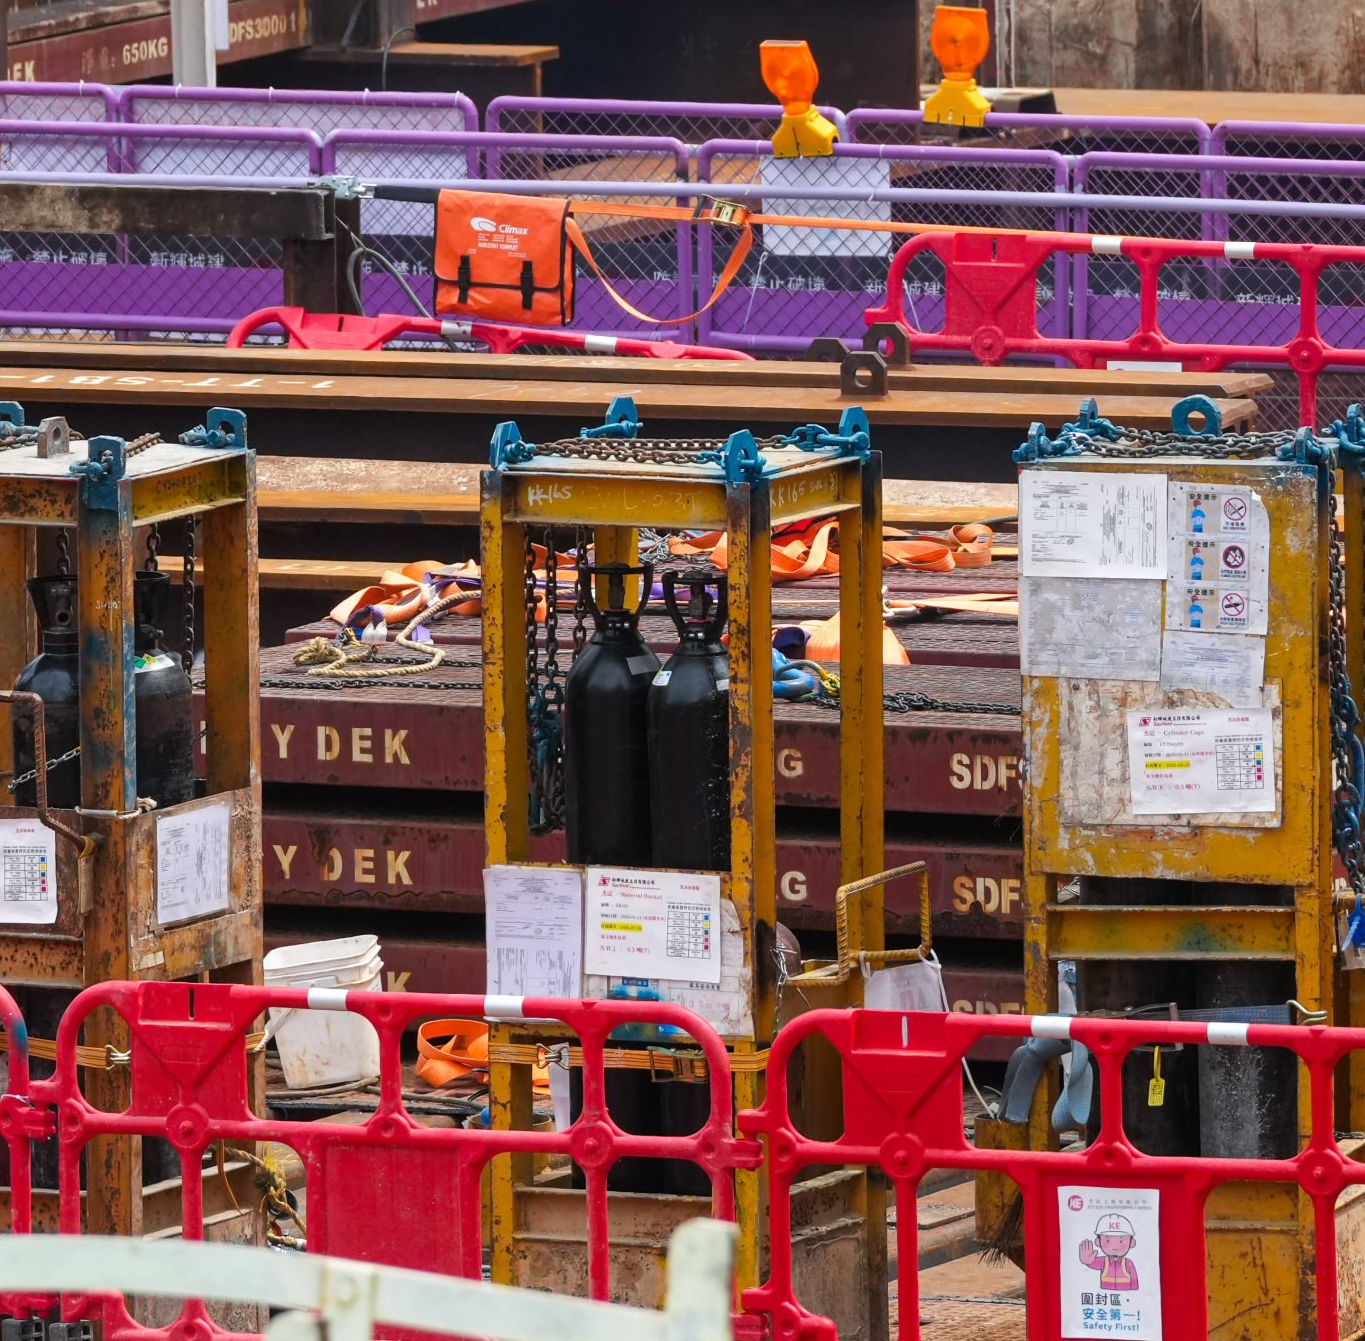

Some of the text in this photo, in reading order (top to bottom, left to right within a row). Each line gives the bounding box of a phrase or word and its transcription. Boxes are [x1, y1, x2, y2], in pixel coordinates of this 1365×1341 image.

[123, 36, 169, 65] 650KG
[499, 224, 529, 235] Climax
[317, 725, 411, 765] DEK
[319, 847, 414, 885] DEK
[620, 891, 643, 899] Material
[1069, 1198, 1082, 1209] KE
[1109, 1222, 1120, 1230] KE
[1083, 1308, 1141, 1321] 安全第一!
[1083, 1321, 1140, 1332] Safety First!
